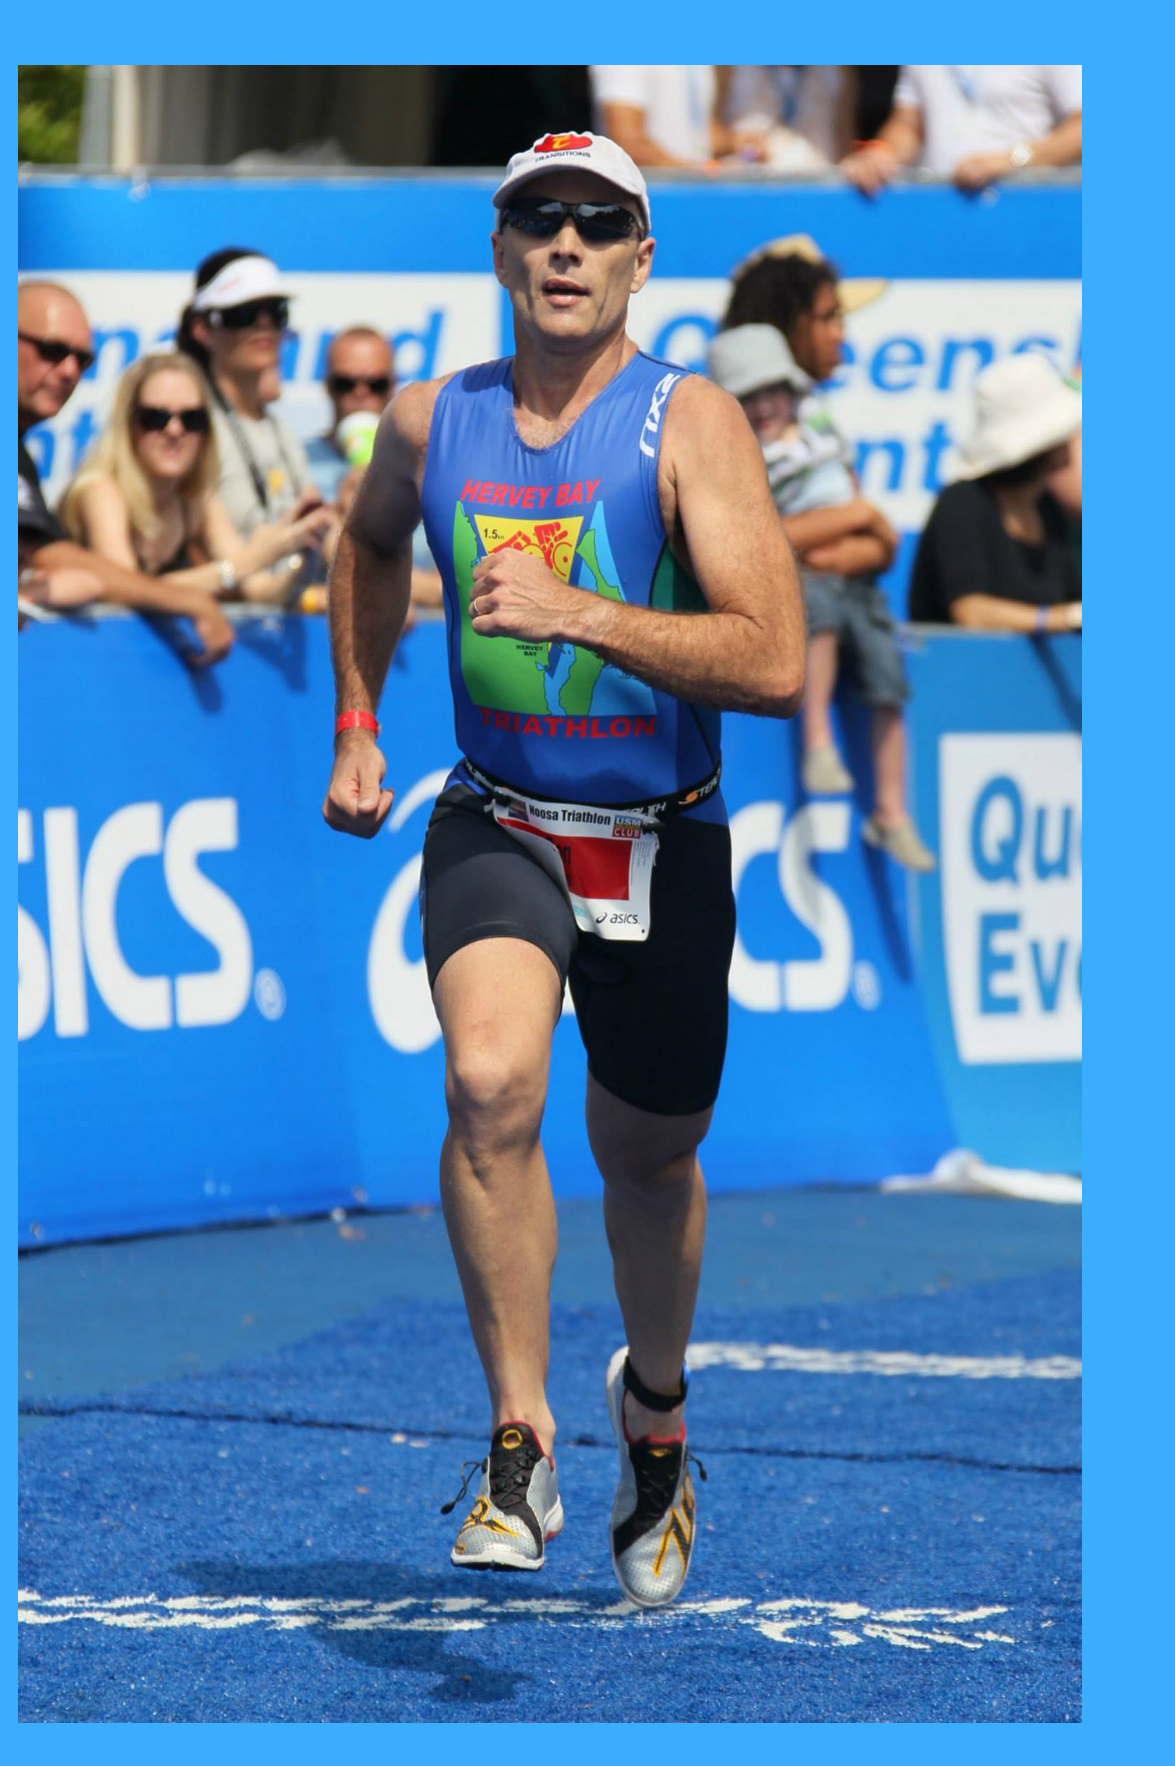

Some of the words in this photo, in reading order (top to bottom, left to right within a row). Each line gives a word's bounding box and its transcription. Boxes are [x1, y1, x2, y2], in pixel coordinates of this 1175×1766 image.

[535, 150, 591, 162] TRANSITIONS
[460, 479, 552, 509] HERVEY
[546, 479, 601, 506] BAY
[479, 708, 656, 738] TRIATHLON
[528, 804, 559, 821] Noosa
[561, 809, 611, 825] Triathlon
[616, 816, 641, 827] USM
[613, 828, 640, 838] CLUB
[610, 913, 638, 924] asics
